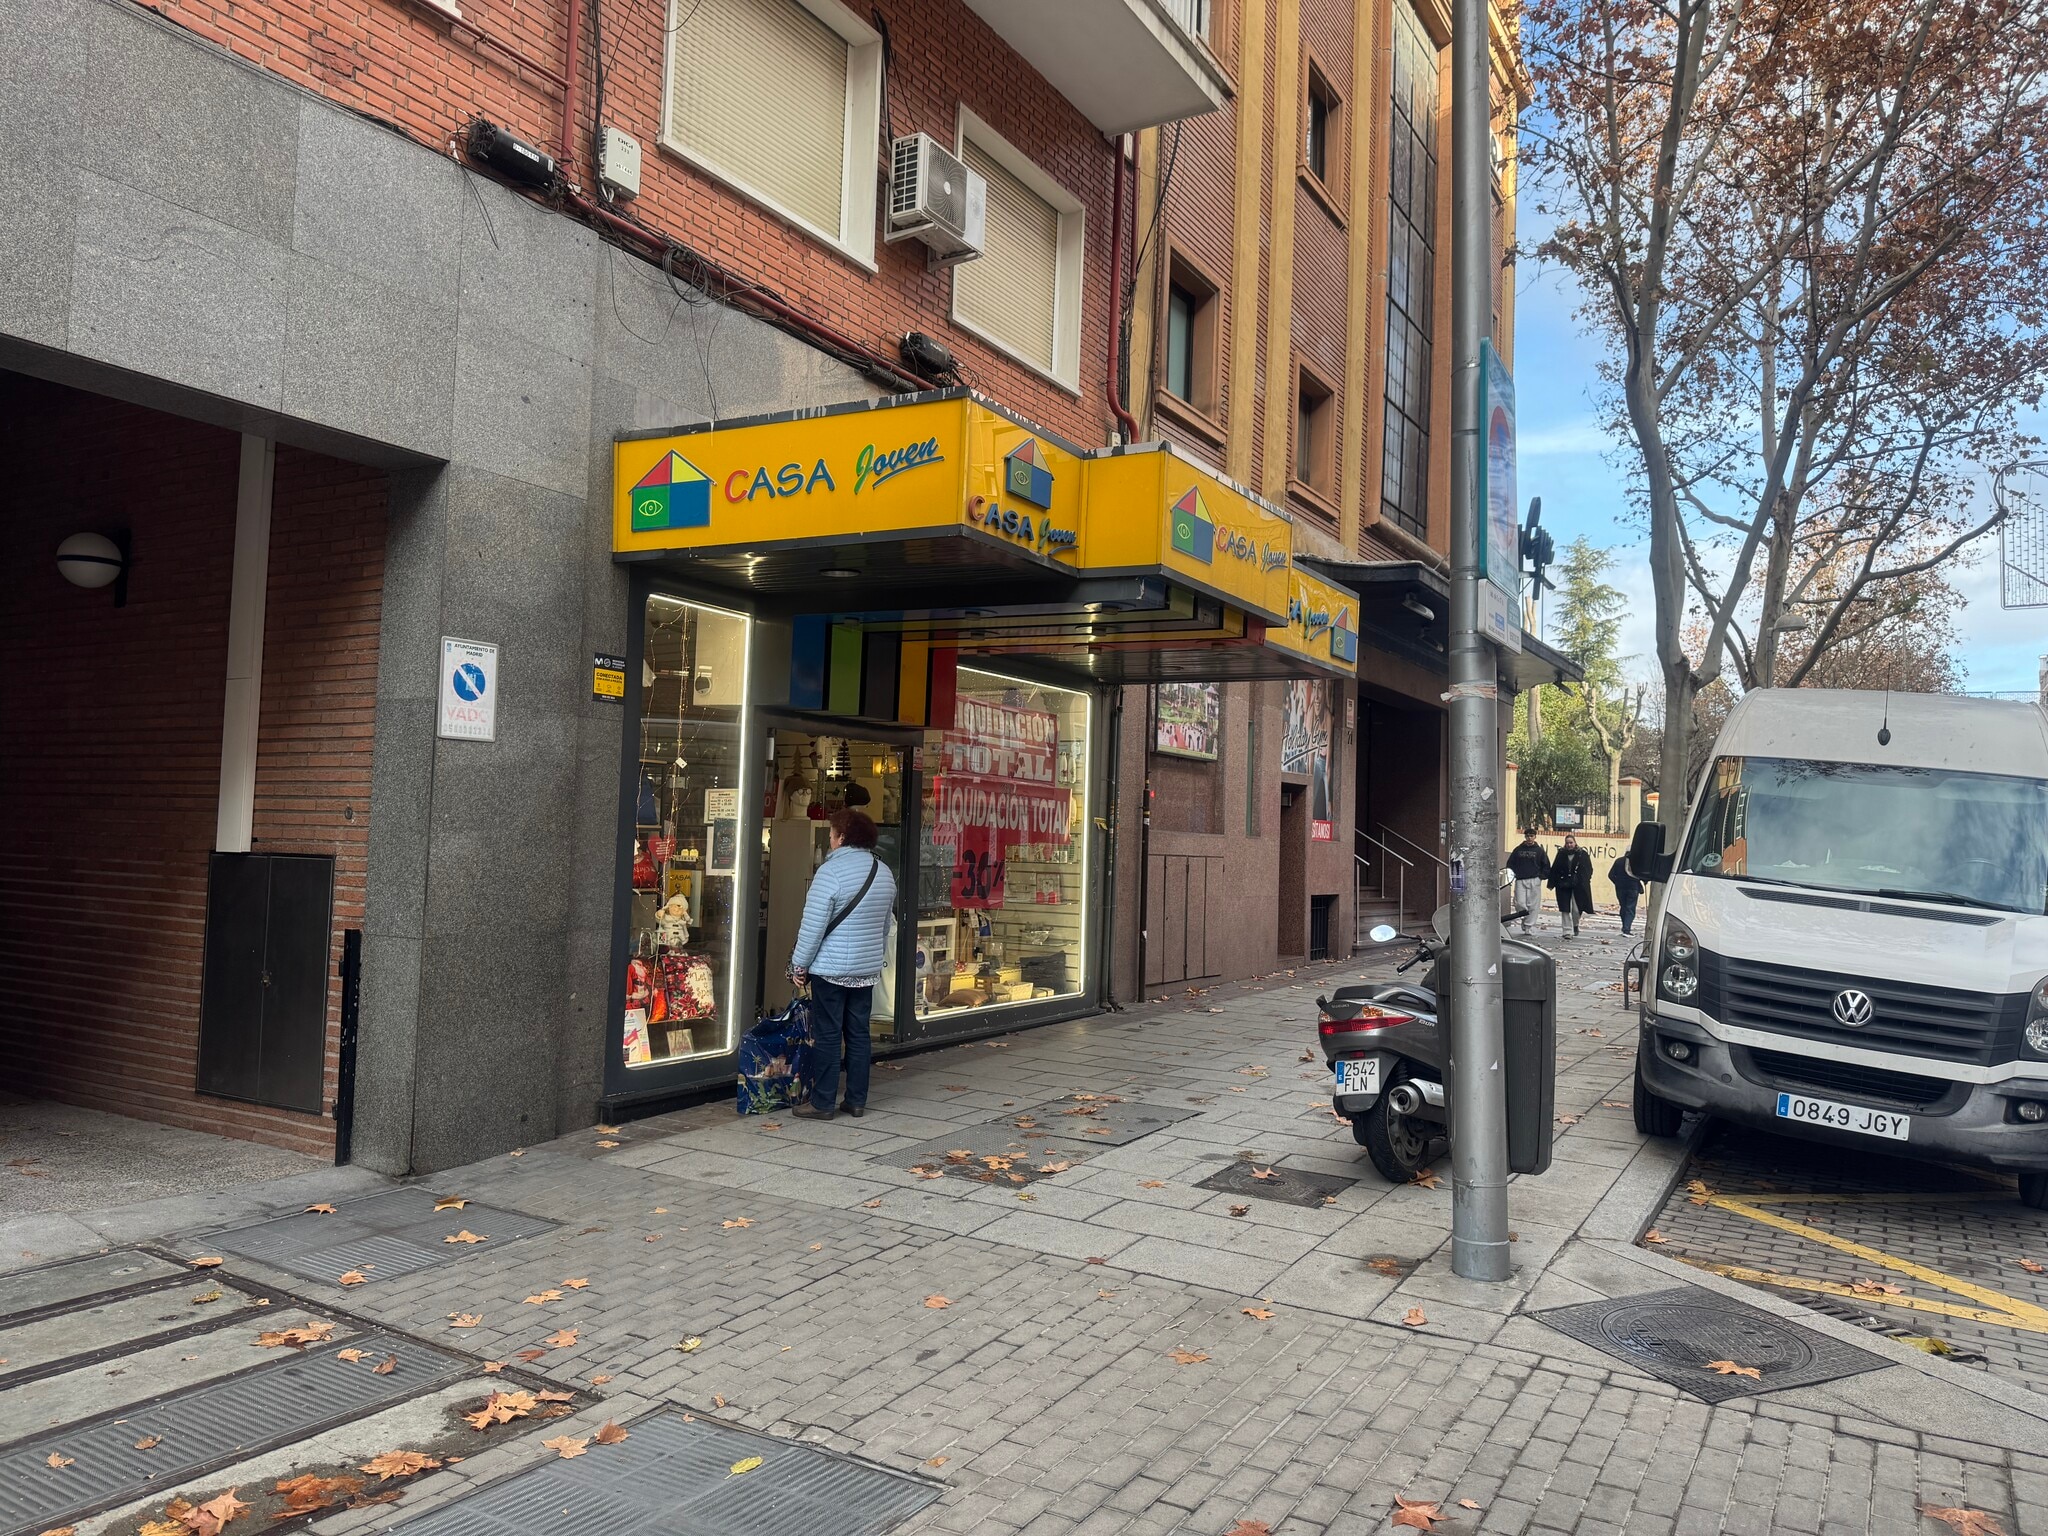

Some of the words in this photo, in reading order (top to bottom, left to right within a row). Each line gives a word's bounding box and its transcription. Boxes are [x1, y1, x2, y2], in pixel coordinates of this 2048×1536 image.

[724, 458, 836, 504] CASA
[853, 437, 941, 496] Joven
[968, 495, 1034, 542] CASA
[1037, 517, 1077, 550] Joven
[1215, 526, 1257, 566] CASA
[1260, 542, 1287, 572] Joven
[454, 643, 488, 653] AYUNTAMIENTO
[466, 650, 483, 658] MADRID
[954, 701, 1055, 744] IQUIDACIÓN
[944, 741, 1053, 782] TOTAL
[939, 784, 1029, 834] LIQUIDACIÓN
[1031, 797, 1071, 836] TOTAL
[1344, 1077, 1368, 1092] FLN
[1345, 1061, 1376, 1077] 2542
[1793, 1099, 1850, 1126] 0849
[1858, 1112, 1903, 1136] JGY
